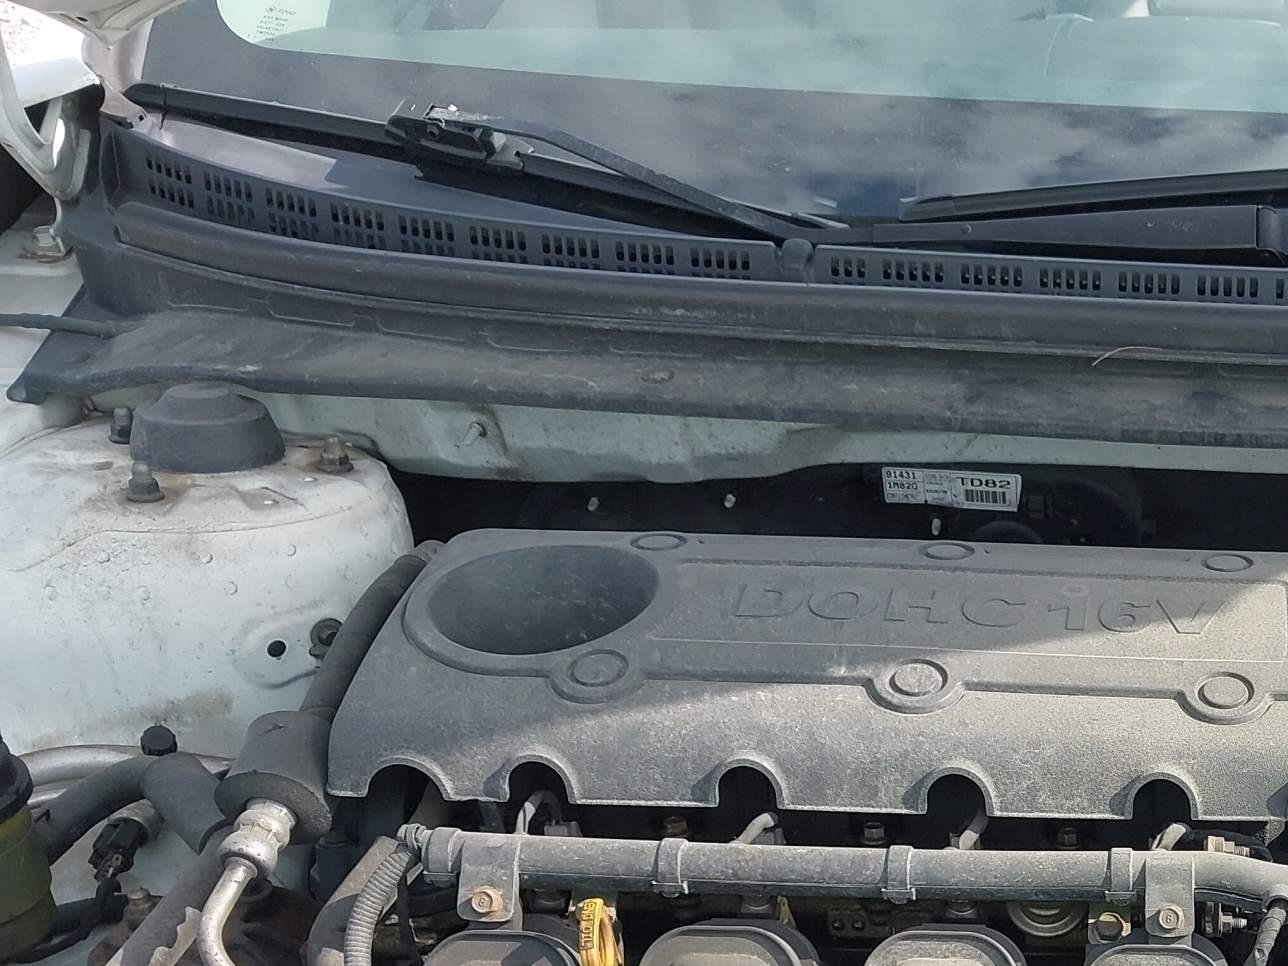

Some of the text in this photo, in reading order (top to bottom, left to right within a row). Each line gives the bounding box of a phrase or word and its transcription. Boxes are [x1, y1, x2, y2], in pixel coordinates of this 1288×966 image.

[955, 476, 1011, 490] TD82
[732, 582, 1027, 630] DOHC
[580, 902, 595, 948] ENG OIL
